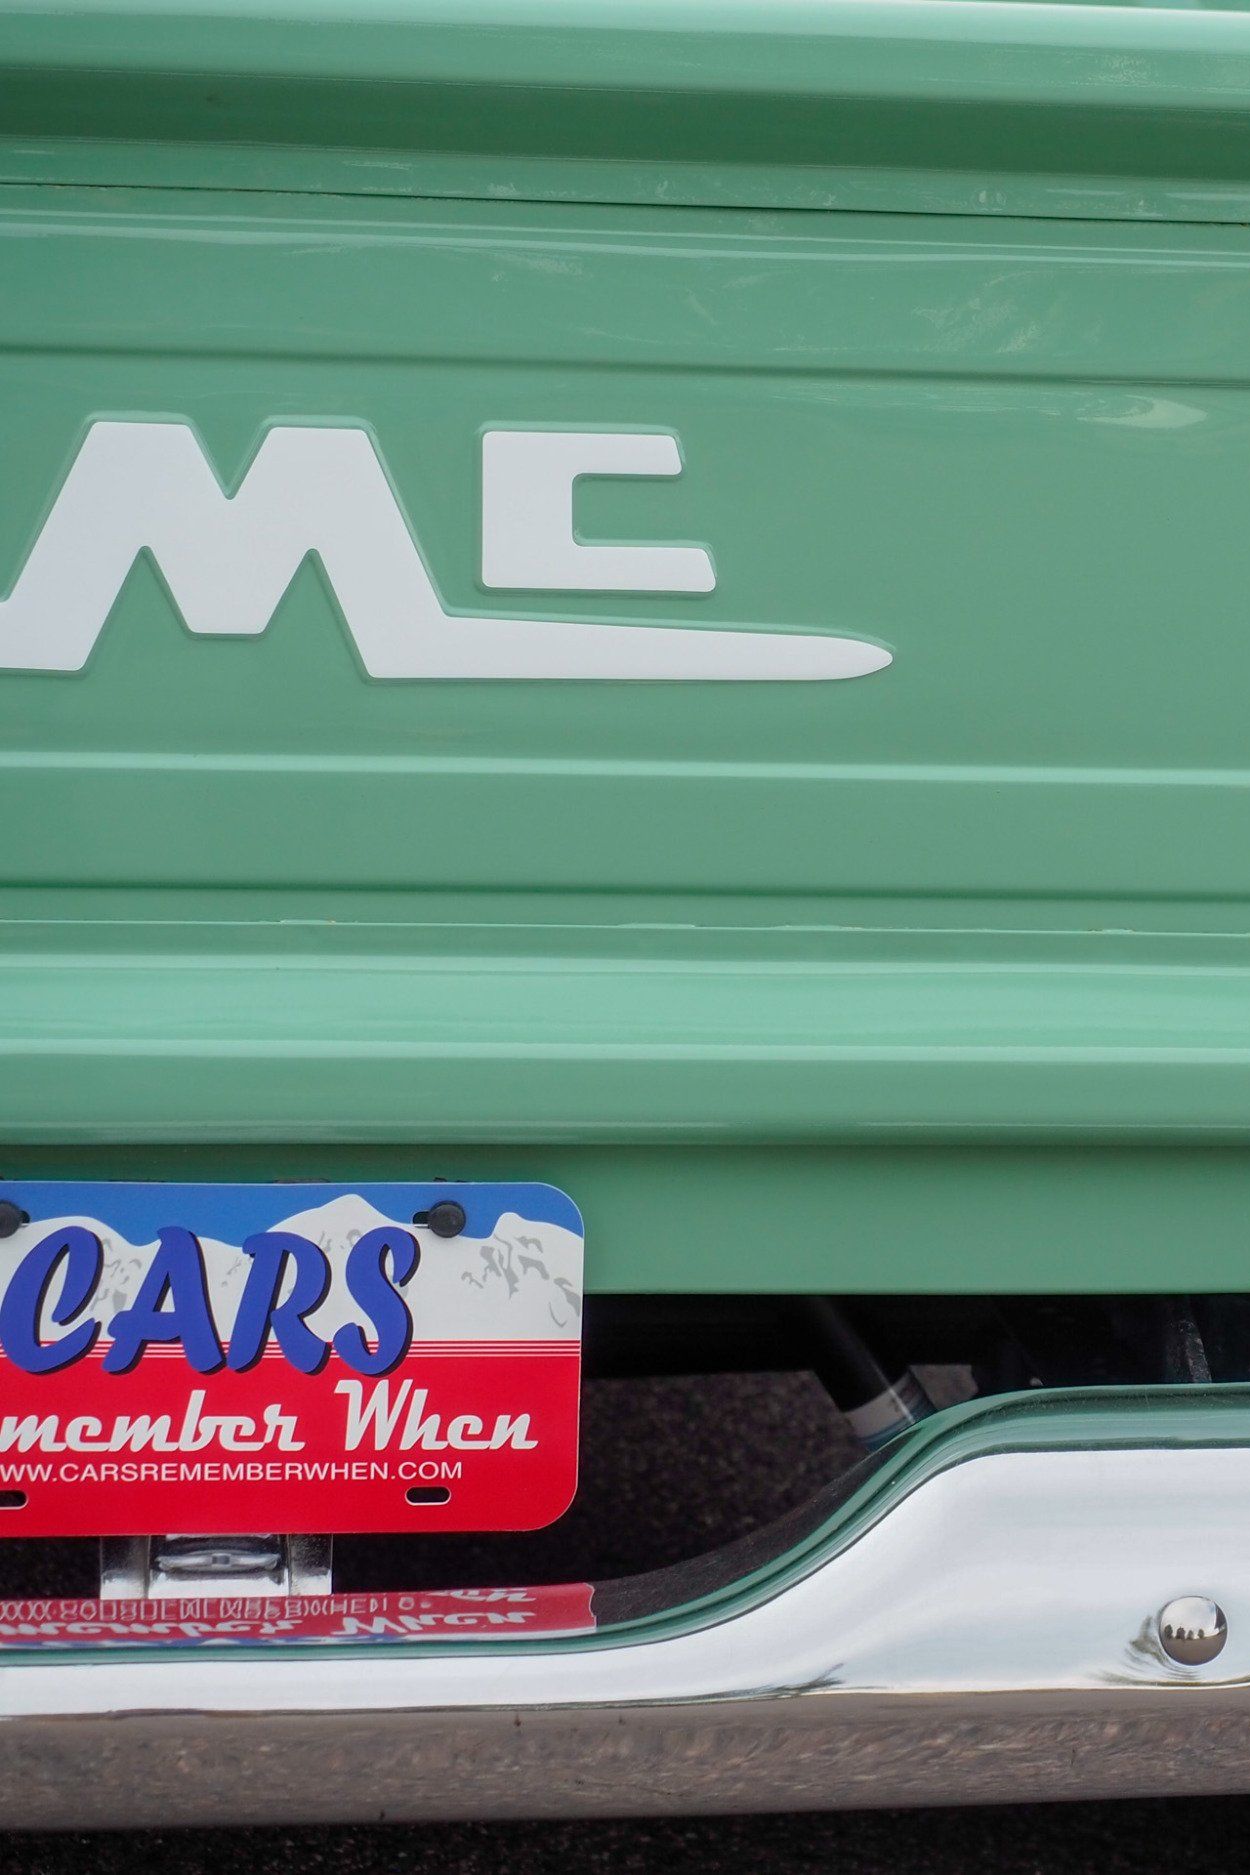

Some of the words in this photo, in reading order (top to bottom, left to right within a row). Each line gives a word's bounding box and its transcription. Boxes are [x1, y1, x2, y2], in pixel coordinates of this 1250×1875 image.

[0, 1226, 421, 1375] CARS
[0, 1389, 306, 1453] member
[333, 1378, 539, 1451] When
[0, 1460, 463, 1483] WW.CARSREMEMBERWHEN.COM
